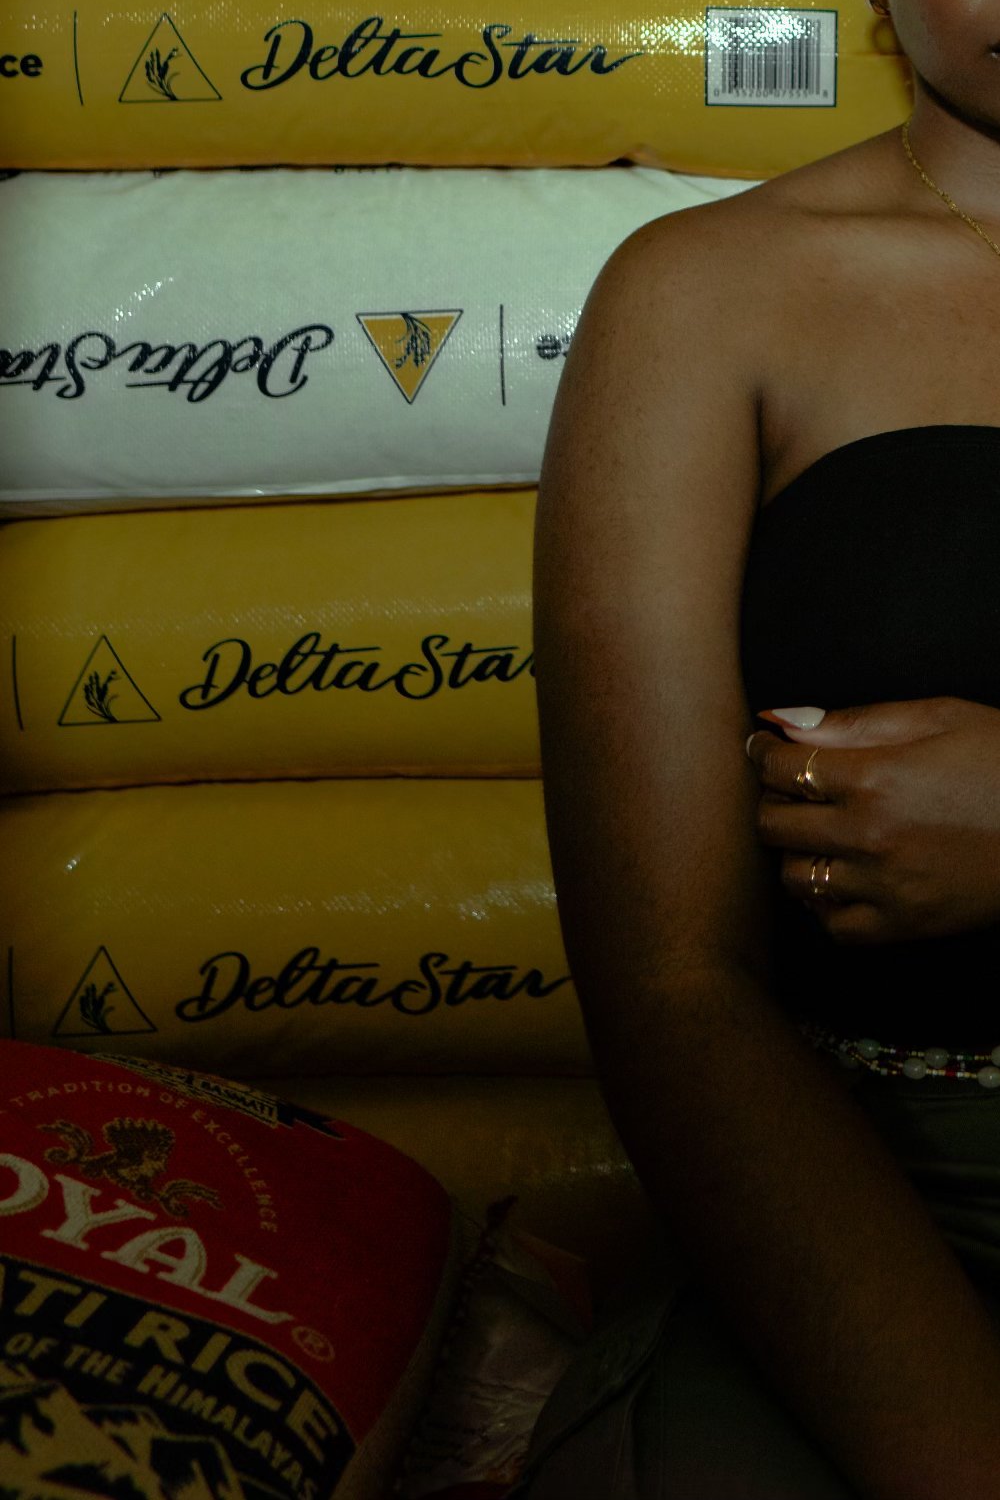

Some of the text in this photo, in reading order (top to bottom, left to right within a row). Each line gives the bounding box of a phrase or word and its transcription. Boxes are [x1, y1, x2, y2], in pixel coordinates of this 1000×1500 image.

[0, 52, 44, 78] ce
[9, 1079, 280, 1234] TRADITION OF EXCELLENCE
[0, 1151, 298, 1325] OYAL
[4, 1332, 61, 1359] OF
[62, 1342, 136, 1388] THE
[123, 1310, 340, 1466] RICE
